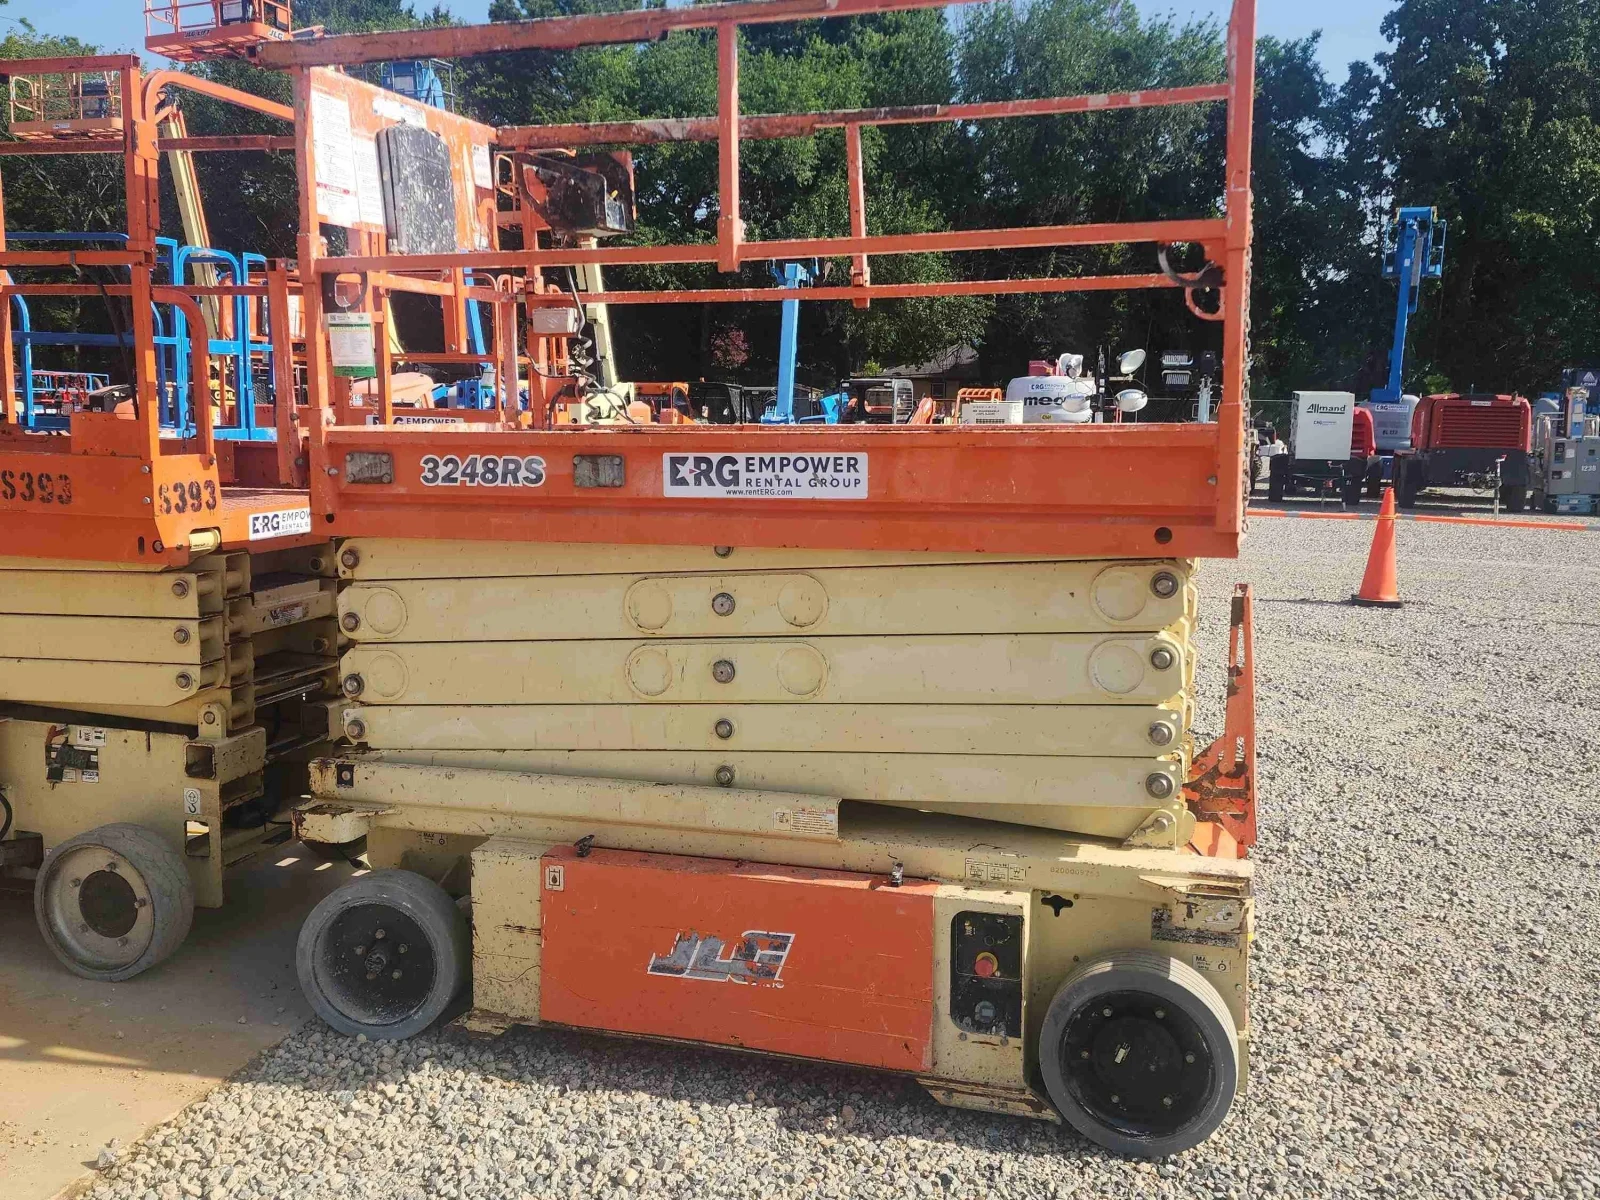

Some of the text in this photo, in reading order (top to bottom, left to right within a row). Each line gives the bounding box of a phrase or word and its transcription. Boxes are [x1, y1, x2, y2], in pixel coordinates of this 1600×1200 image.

[268, 28, 284, 39] JLG
[1306, 403, 1346, 413] Allmand
[421, 455, 546, 486] 3248RS
[669, 456, 860, 487] ERG EMPOWER
[1, 470, 73, 504] S393
[726, 488, 793, 496] www.rentERG.com
[745, 478, 861, 488] RENTAL GROUP
[158, 480, 217, 514] S393
[252, 513, 280, 534] ERG
